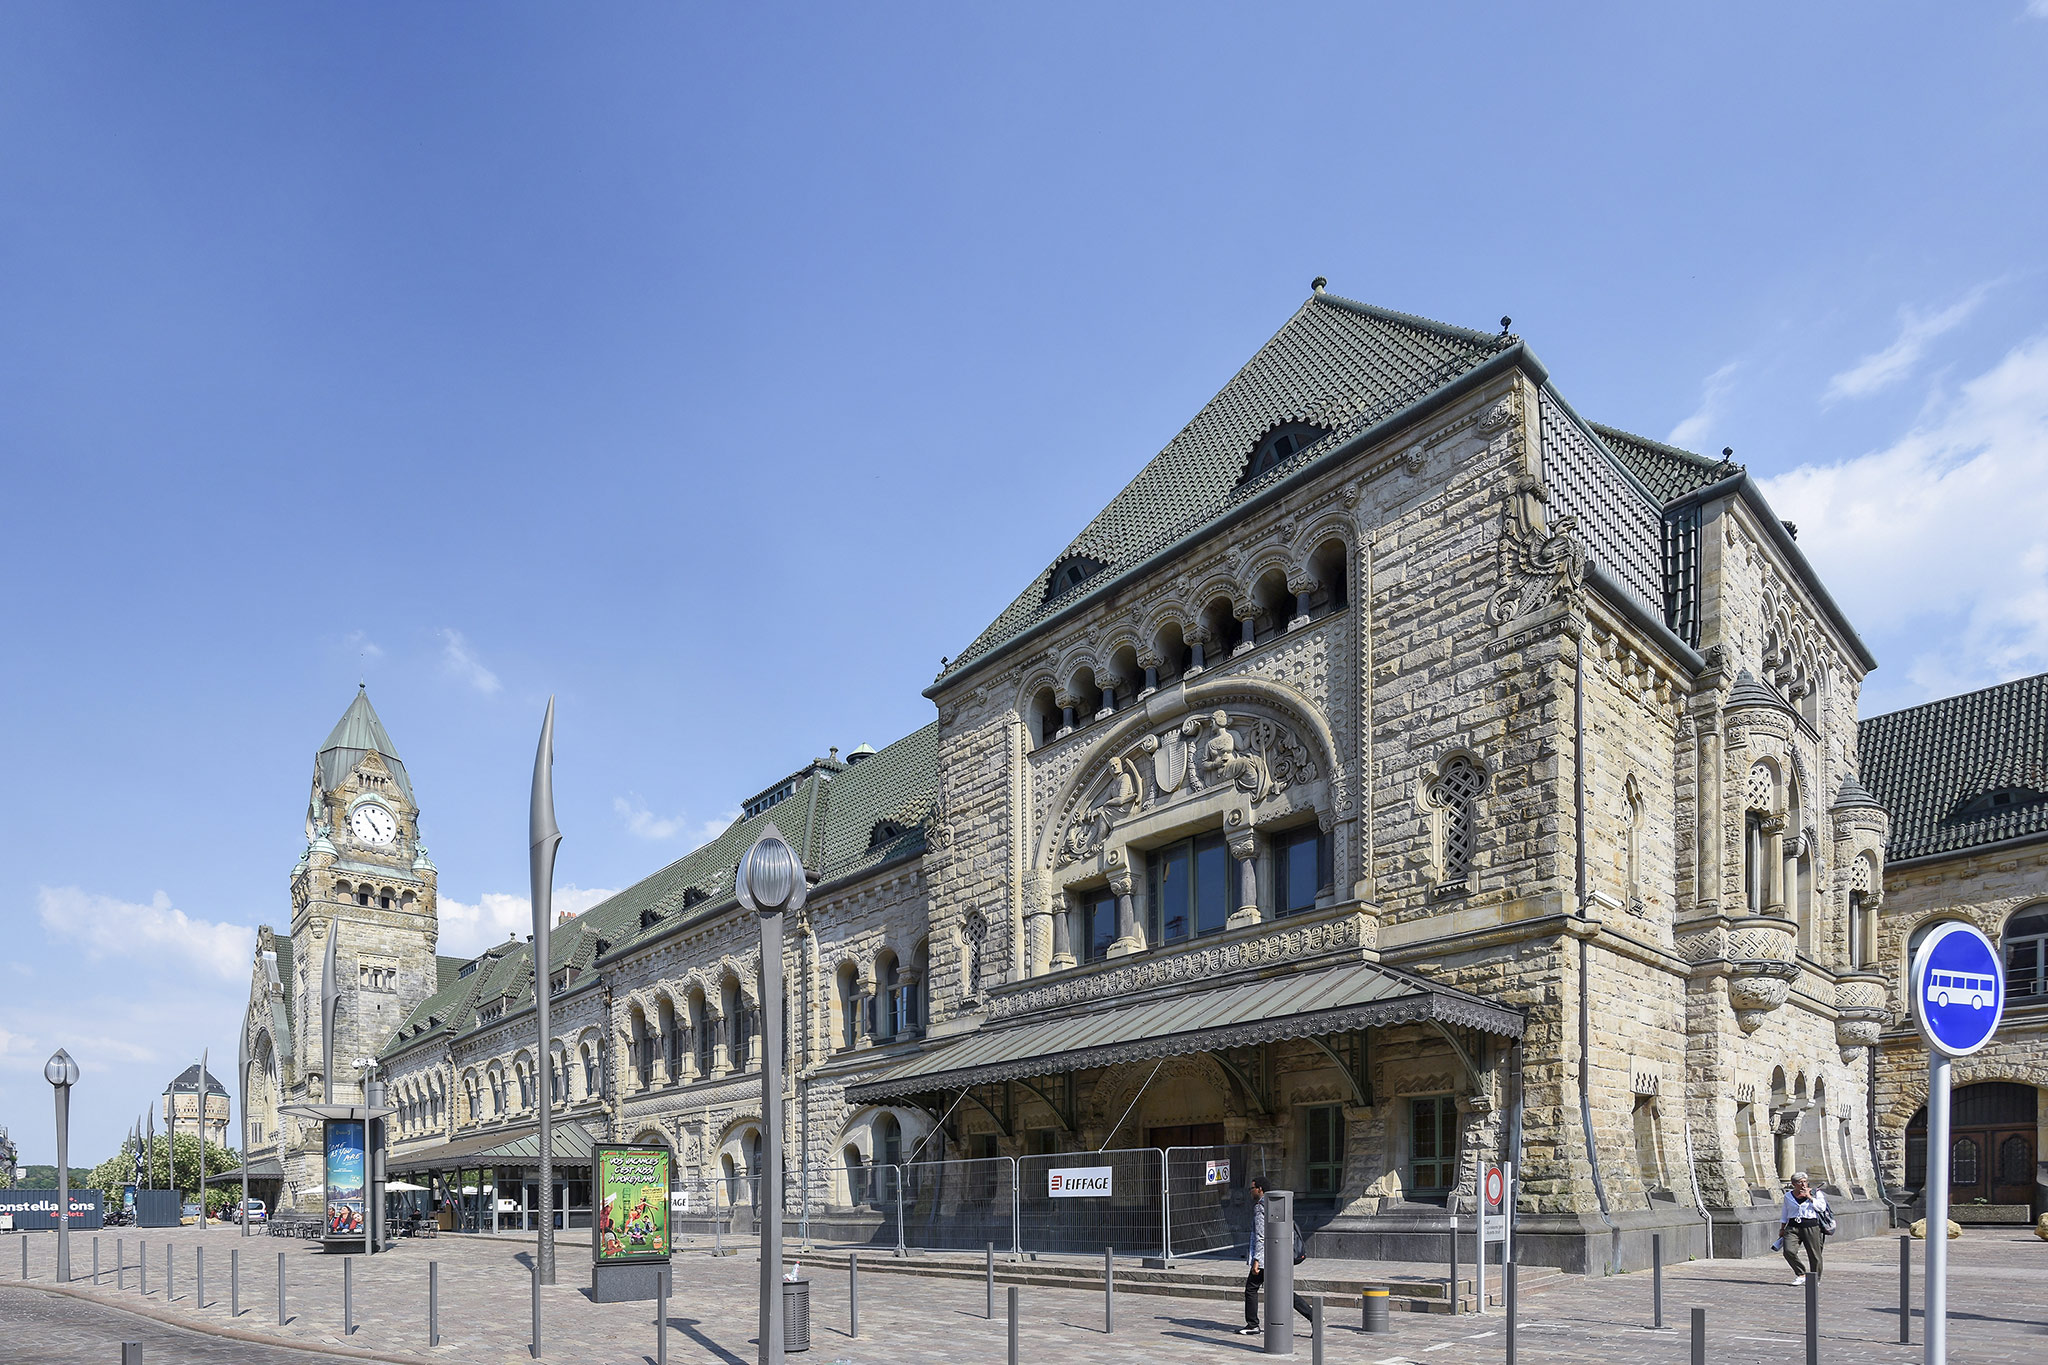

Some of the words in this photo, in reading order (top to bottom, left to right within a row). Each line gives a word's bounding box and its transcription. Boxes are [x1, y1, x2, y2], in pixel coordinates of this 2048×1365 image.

[610, 1157, 624, 1166] VOS
[1065, 1177, 1109, 1190] EIFFAGE
[671, 1198, 686, 1207] AGE
